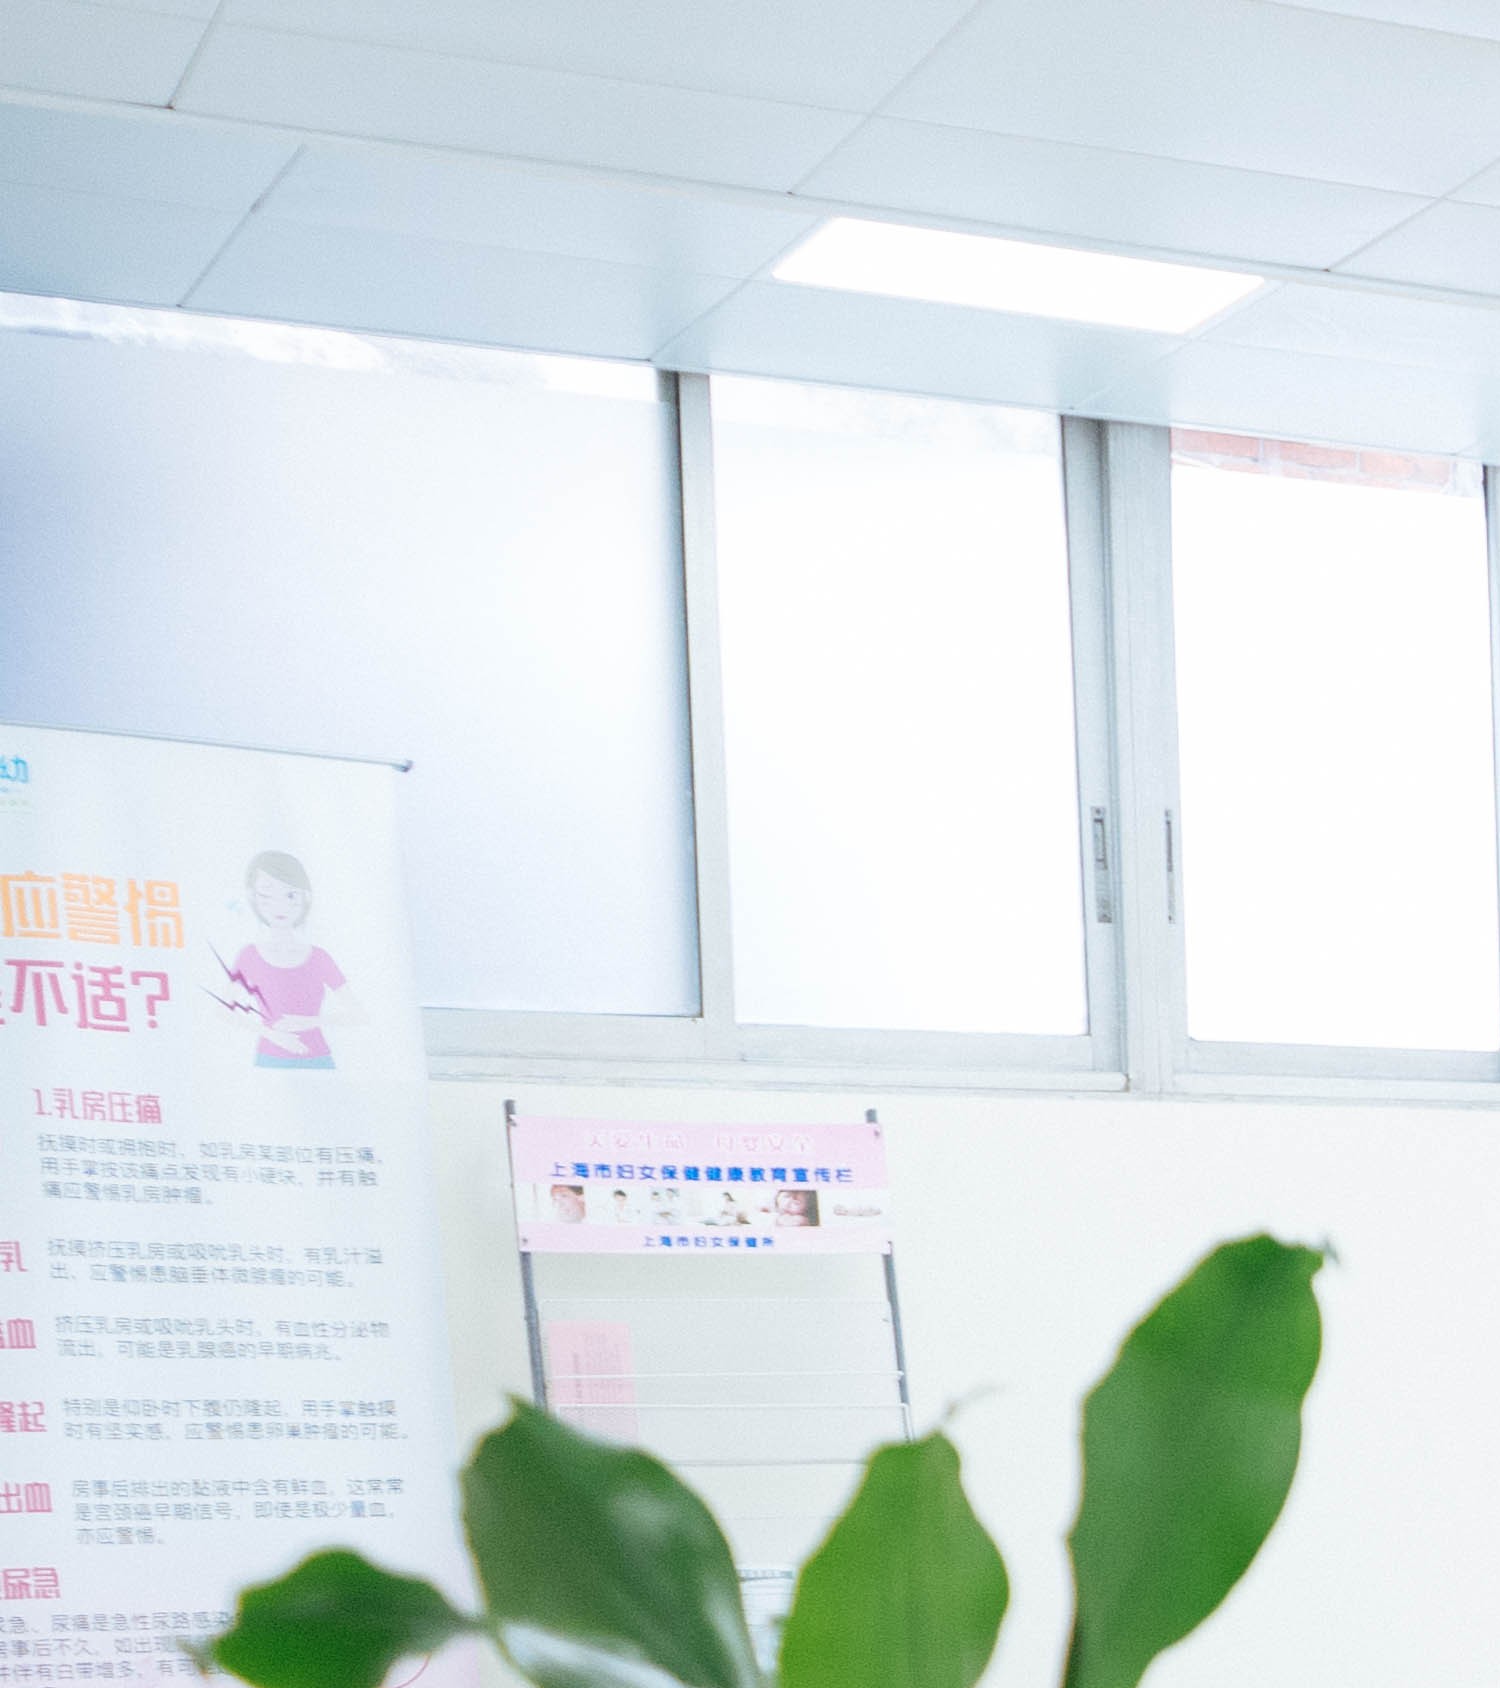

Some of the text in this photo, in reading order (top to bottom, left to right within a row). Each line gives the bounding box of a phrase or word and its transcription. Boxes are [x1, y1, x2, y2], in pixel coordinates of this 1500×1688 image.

[0, 870, 184, 948] 应警惕
[0, 959, 170, 1032] 不适？
[32, 1088, 162, 1124] 1.乳房压痛
[551, 1162, 853, 1184] 上海市妇女保健健康教育宣传栏
[0, 1318, 37, 1350] 血
